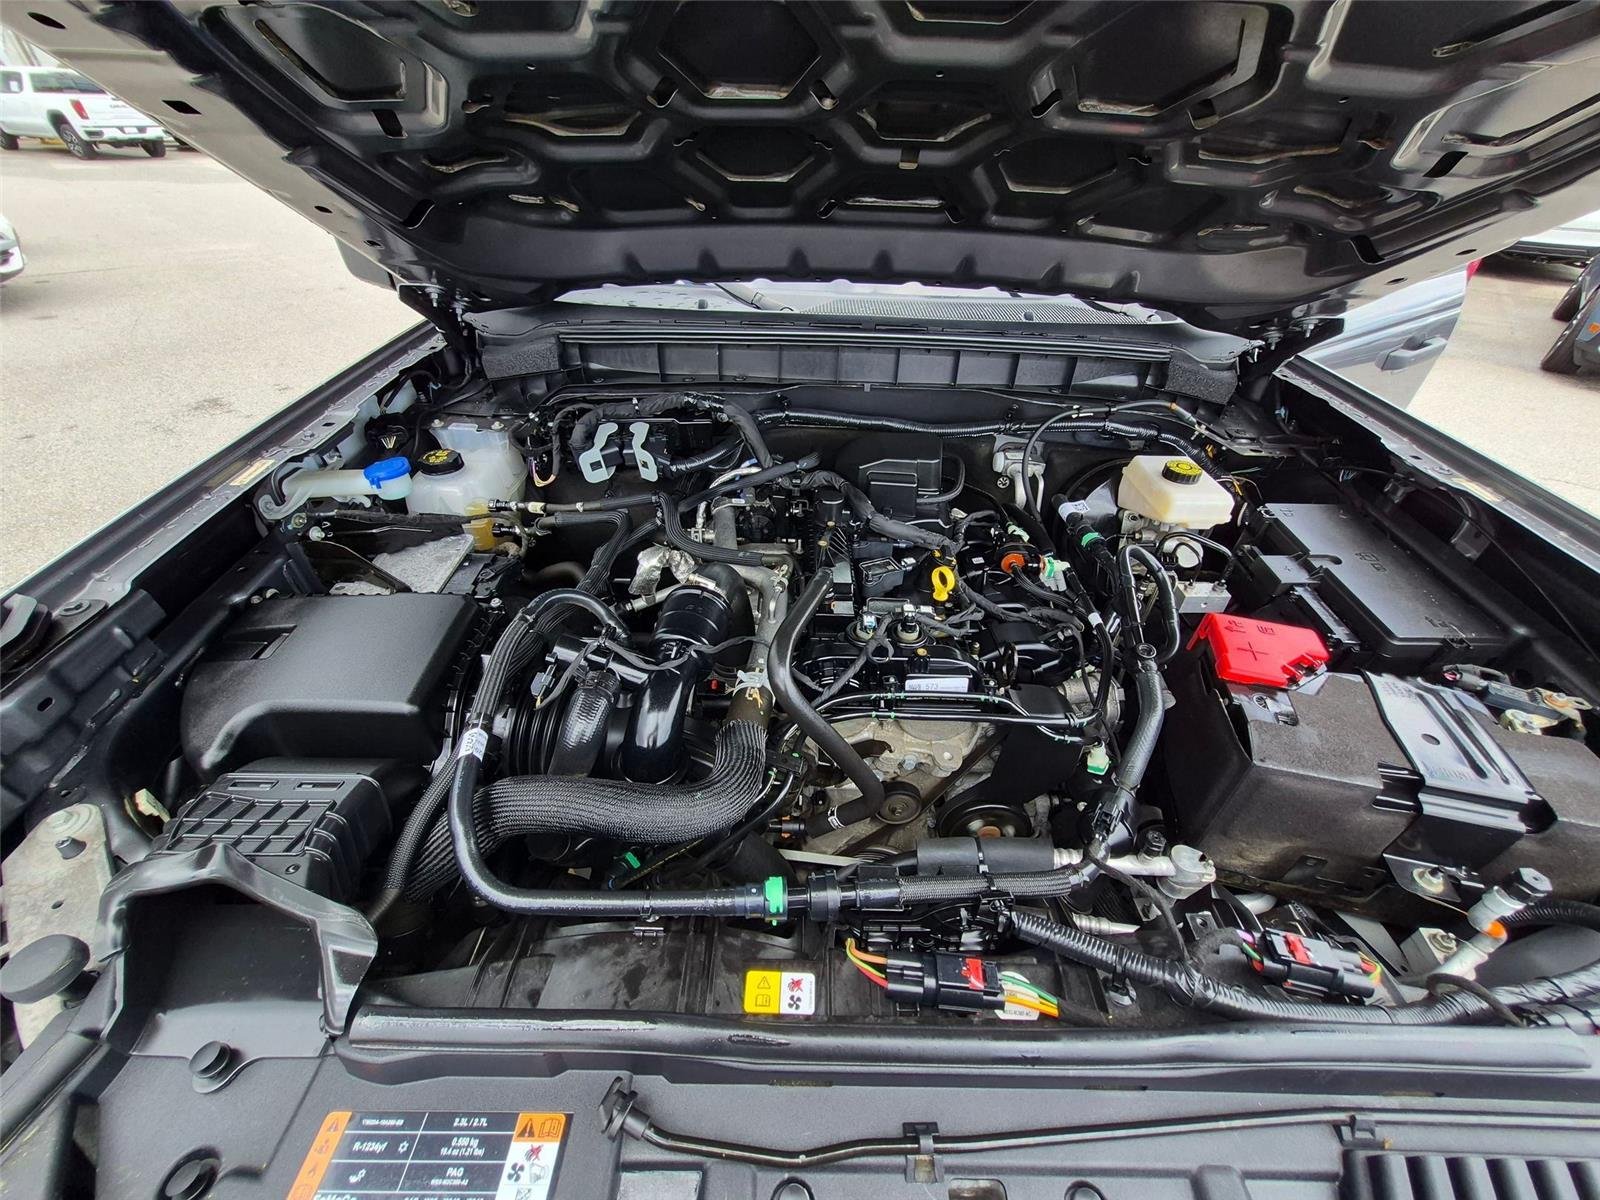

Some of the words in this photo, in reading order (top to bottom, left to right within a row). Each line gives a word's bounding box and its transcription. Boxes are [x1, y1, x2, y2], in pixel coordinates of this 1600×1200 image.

[453, 1118, 468, 1127] 2.3L
[473, 1118, 488, 1127] 2.7L
[352, 1142, 388, 1153] R-1234yf
[470, 1136, 480, 1149] kg
